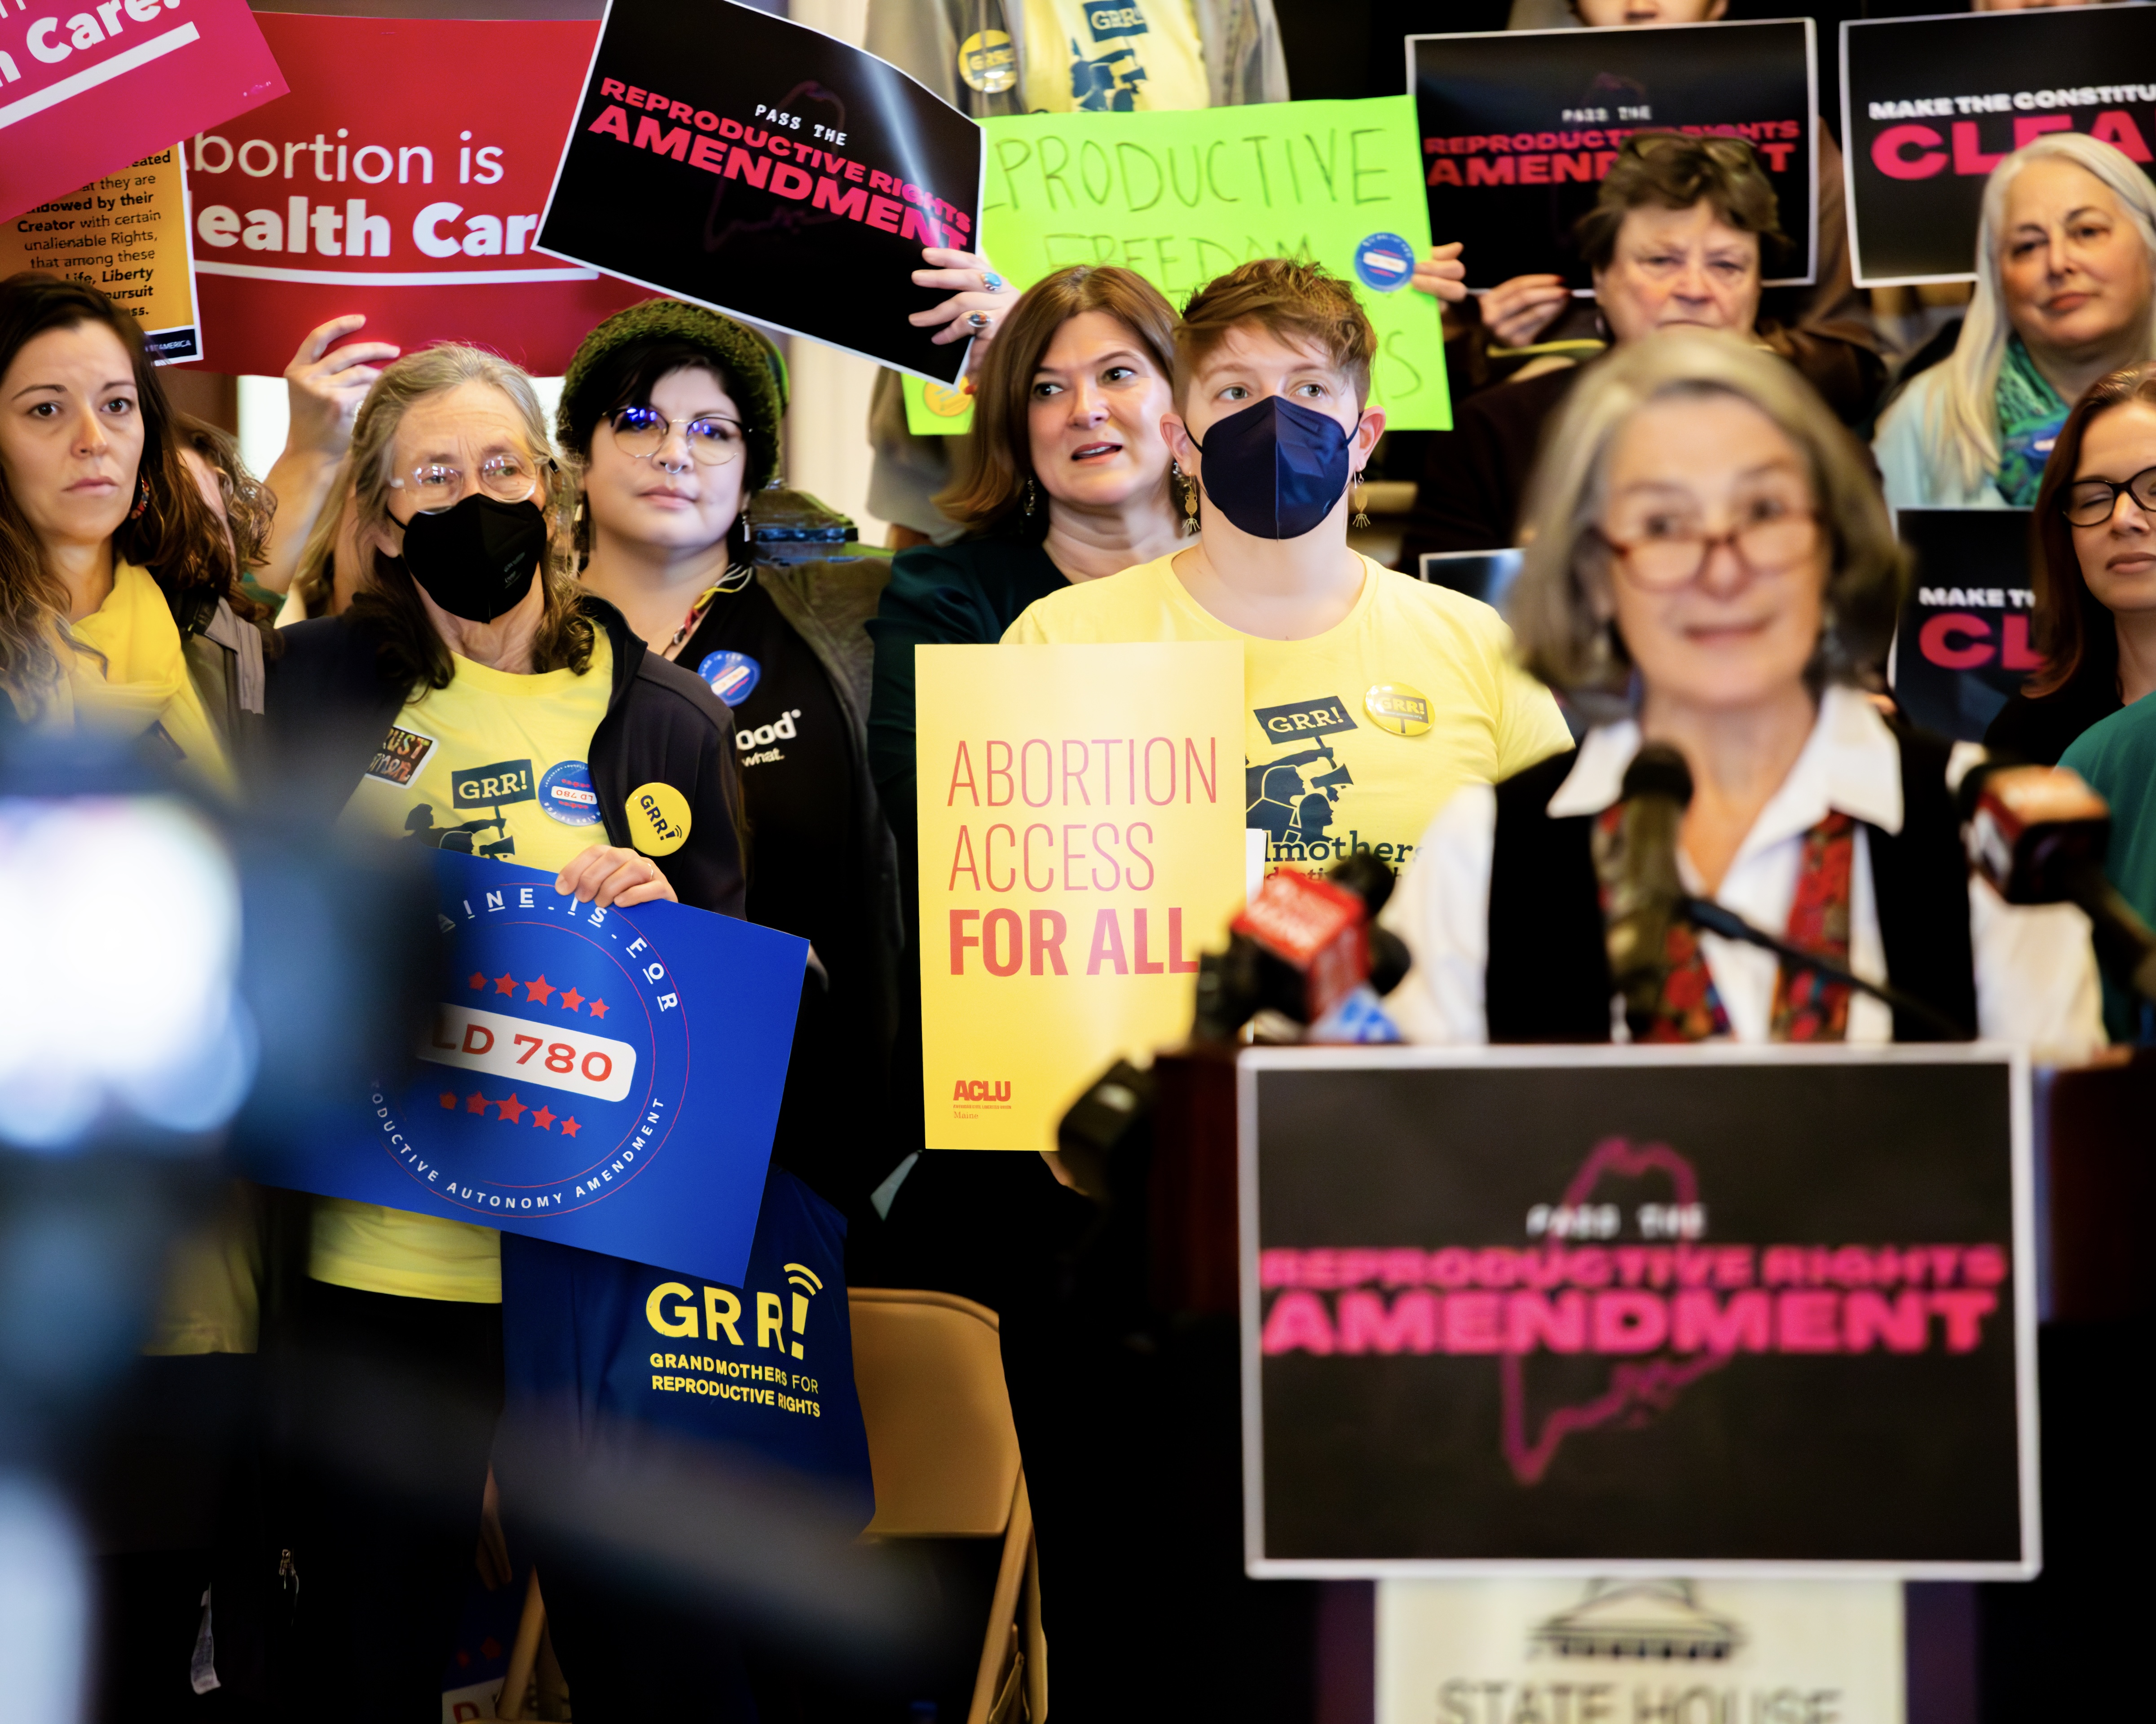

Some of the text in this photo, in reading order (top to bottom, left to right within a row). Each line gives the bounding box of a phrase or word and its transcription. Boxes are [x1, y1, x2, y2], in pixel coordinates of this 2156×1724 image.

[755, 104, 848, 146] PASS THE
[185, 128, 504, 185] bortion is
[588, 105, 967, 251] AMENDMENT
[600, 77, 971, 233] REPRODUCTIVE RIGHTS
[982, 128, 1392, 212] PRODUCTIVE
[97, 196, 115, 211] by
[120, 192, 154, 206] their
[100, 176, 130, 191] they
[135, 174, 156, 185] are
[18, 210, 161, 233] Creator with certain
[24, 230, 158, 251] unalienable Rights,
[187, 190, 538, 258] ealth Car
[31, 256, 59, 269] that
[118, 250, 155, 262] these
[102, 268, 154, 283] Liberty
[1267, 706, 1344, 734] GRR!
[459, 770, 528, 799] GRR!
[556, 790, 577, 799] 780
[947, 737, 1217, 808] ABORTION
[640, 795, 676, 841] GRR!
[948, 822, 1155, 893] ACCESS
[949, 907, 1068, 977] FOR
[1086, 907, 1199, 976] ALL
[626, 937, 678, 1012] FOR
[432, 1020, 613, 1082] LD 780
[953, 1080, 1011, 1102] ACLU
[446, 1182, 562, 1209] AUTONOMY
[575, 1098, 664, 1198] AMENDMENT
[1259, 1243, 2007, 1289] REPRODUCTIVE RIGHTS
[646, 1281, 809, 1360] GRR!
[1260, 1287, 1997, 1355] AMENDMENT
[650, 1353, 819, 1394] GRANDMOTHERS FOR
[652, 1375, 820, 1417] REPRODUCTIVE RIGHTS
[1437, 1677, 1842, 1724] STATE HOUSE
